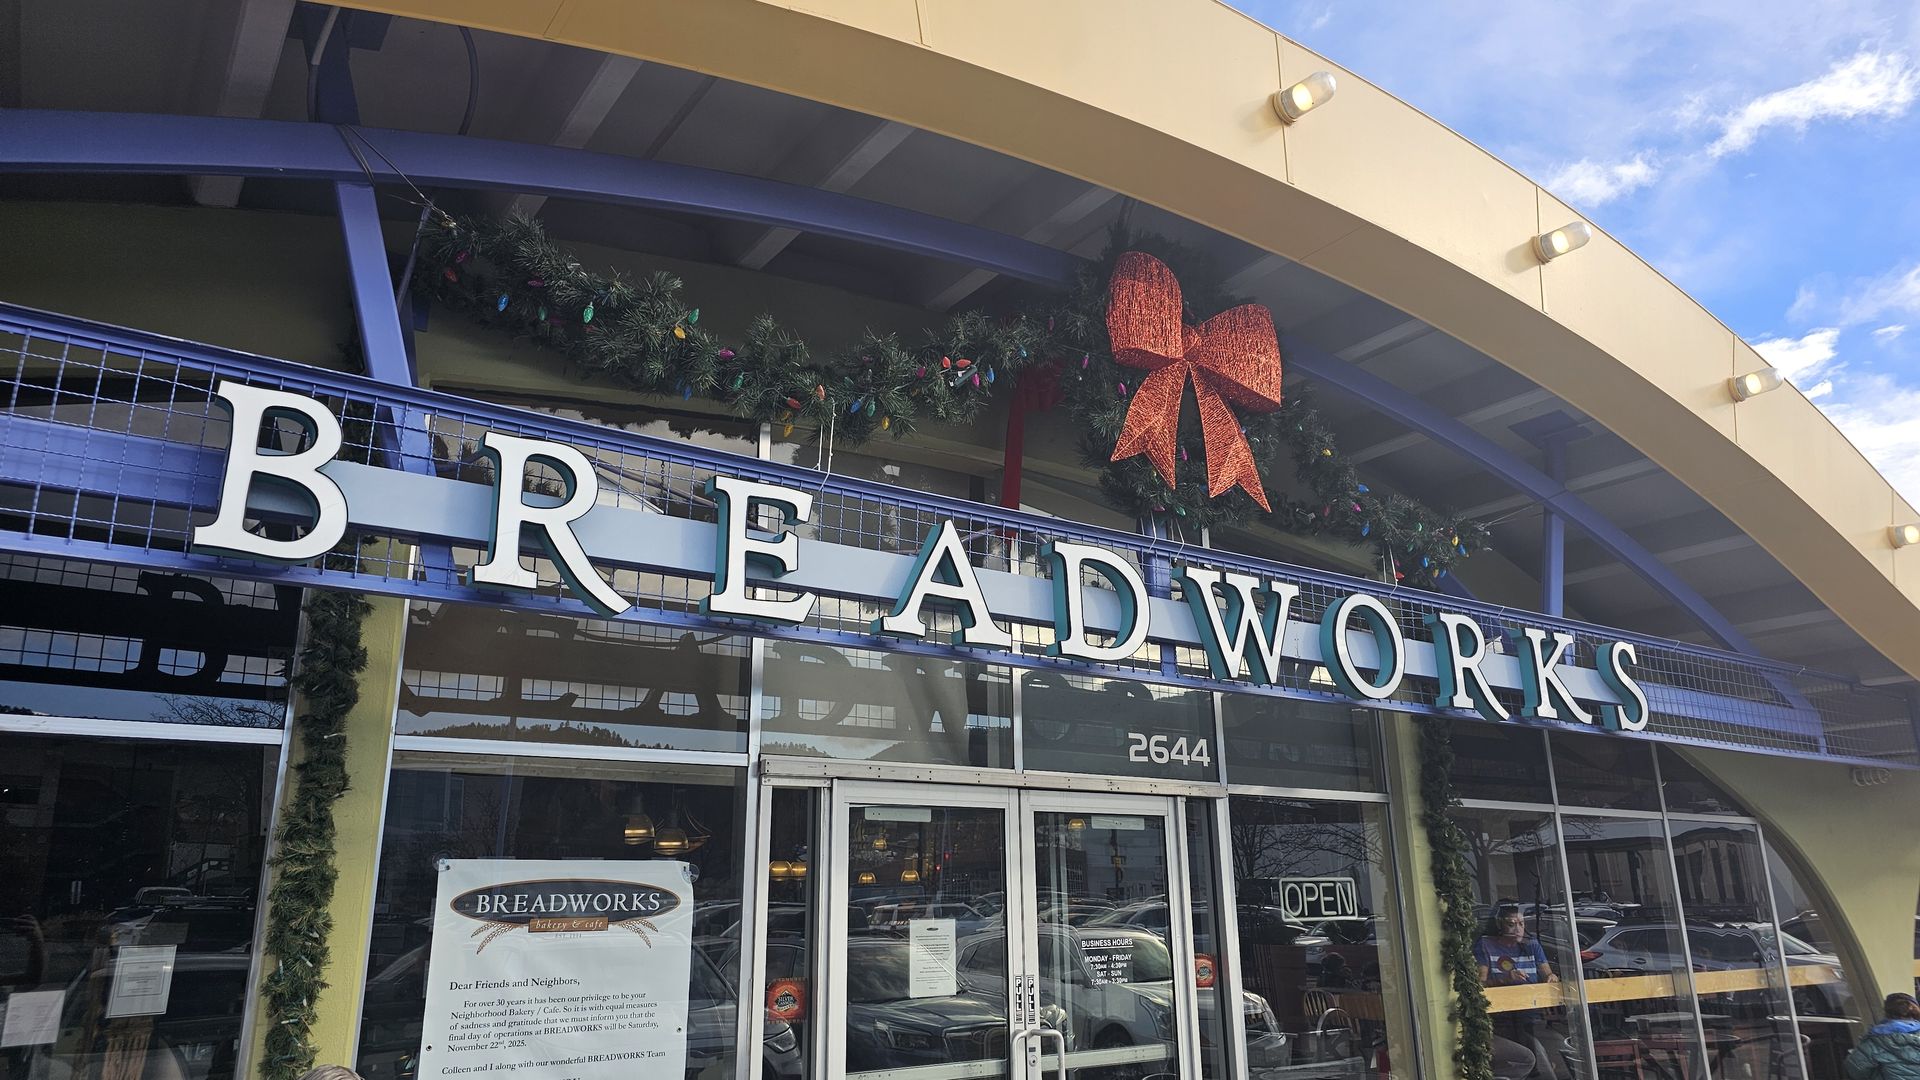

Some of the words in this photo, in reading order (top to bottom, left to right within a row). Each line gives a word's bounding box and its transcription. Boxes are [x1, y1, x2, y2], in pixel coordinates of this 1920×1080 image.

[193, 379, 1649, 733] BREADWORKS
[1128, 732, 1211, 767] 2644
[475, 892, 661, 914] BREADWORKS
[1284, 882, 1354, 917] OPEN
[535, 919, 567, 932] bakery
[571, 919, 581, 928] &
[585, 919, 603, 931] cafe
[1081, 939, 1111, 948] BUSINESS
[1112, 938, 1133, 946] HOURS
[1084, 954, 1108, 963] MONDAY
[1112, 953, 1132, 961] FRIDAY
[1096, 970, 1107, 978] SAT
[449, 981, 472, 991] Dear
[475, 979, 510, 989] Friends
[512, 978, 529, 988] and
[530, 977, 580, 989] Neighbors,
[464, 1000, 477, 1008] For
[496, 999, 505, 1007] 30
[506, 999, 526, 1008] years
[527, 997, 533, 1005] it
[548, 996, 566, 1004] been
[581, 993, 611, 1004] privilege
[630, 992, 646, 1001] your
[451, 1009, 507, 1020] Neighborhood
[508, 1007, 534, 1017] Bakery
[536, 1006, 541, 1015] /
[563, 1005, 572, 1013] So
[574, 1004, 579, 1012] it
[581, 1004, 587, 1012] is
[588, 1003, 604, 1011] with
[605, 1002, 624, 1012] equal
[625, 1001, 658, 1009] measures
[449, 1023, 458, 1031] of
[460, 1021, 490, 1030] sadness
[492, 1019, 506, 1027] and
[508, 1018, 542, 1029] gratitude
[543, 1016, 558, 1025] that
[571, 1015, 589, 1023] must
[590, 1013, 614, 1022] inform
[615, 1013, 629, 1022] you
[629, 1011, 643, 1019] that
[644, 1010, 655, 1018] the
[448, 1032, 466, 1041] final
[467, 1031, 481, 1041] day
[482, 1031, 492, 1039] of
[493, 1029, 533, 1040] operations
[534, 1028, 542, 1036] at
[543, 1024, 603, 1035] BREADWORKS
[604, 1022, 617, 1031] will
[619, 1021, 627, 1030] be
[628, 1020, 659, 1030] Saturday,
[447, 1043, 488, 1053] November
[508, 1039, 527, 1048] 2025.
[441, 1064, 472, 1075] Colleen
[473, 1063, 488, 1073] and
[489, 1062, 493, 1071] I
[495, 1061, 517, 1072] along
[518, 1059, 534, 1069] with
[535, 1059, 549, 1067] our
[550, 1055, 586, 1066] wonderful
[587, 1051, 645, 1063] BREADWORKS
[646, 1050, 666, 1059] Team
